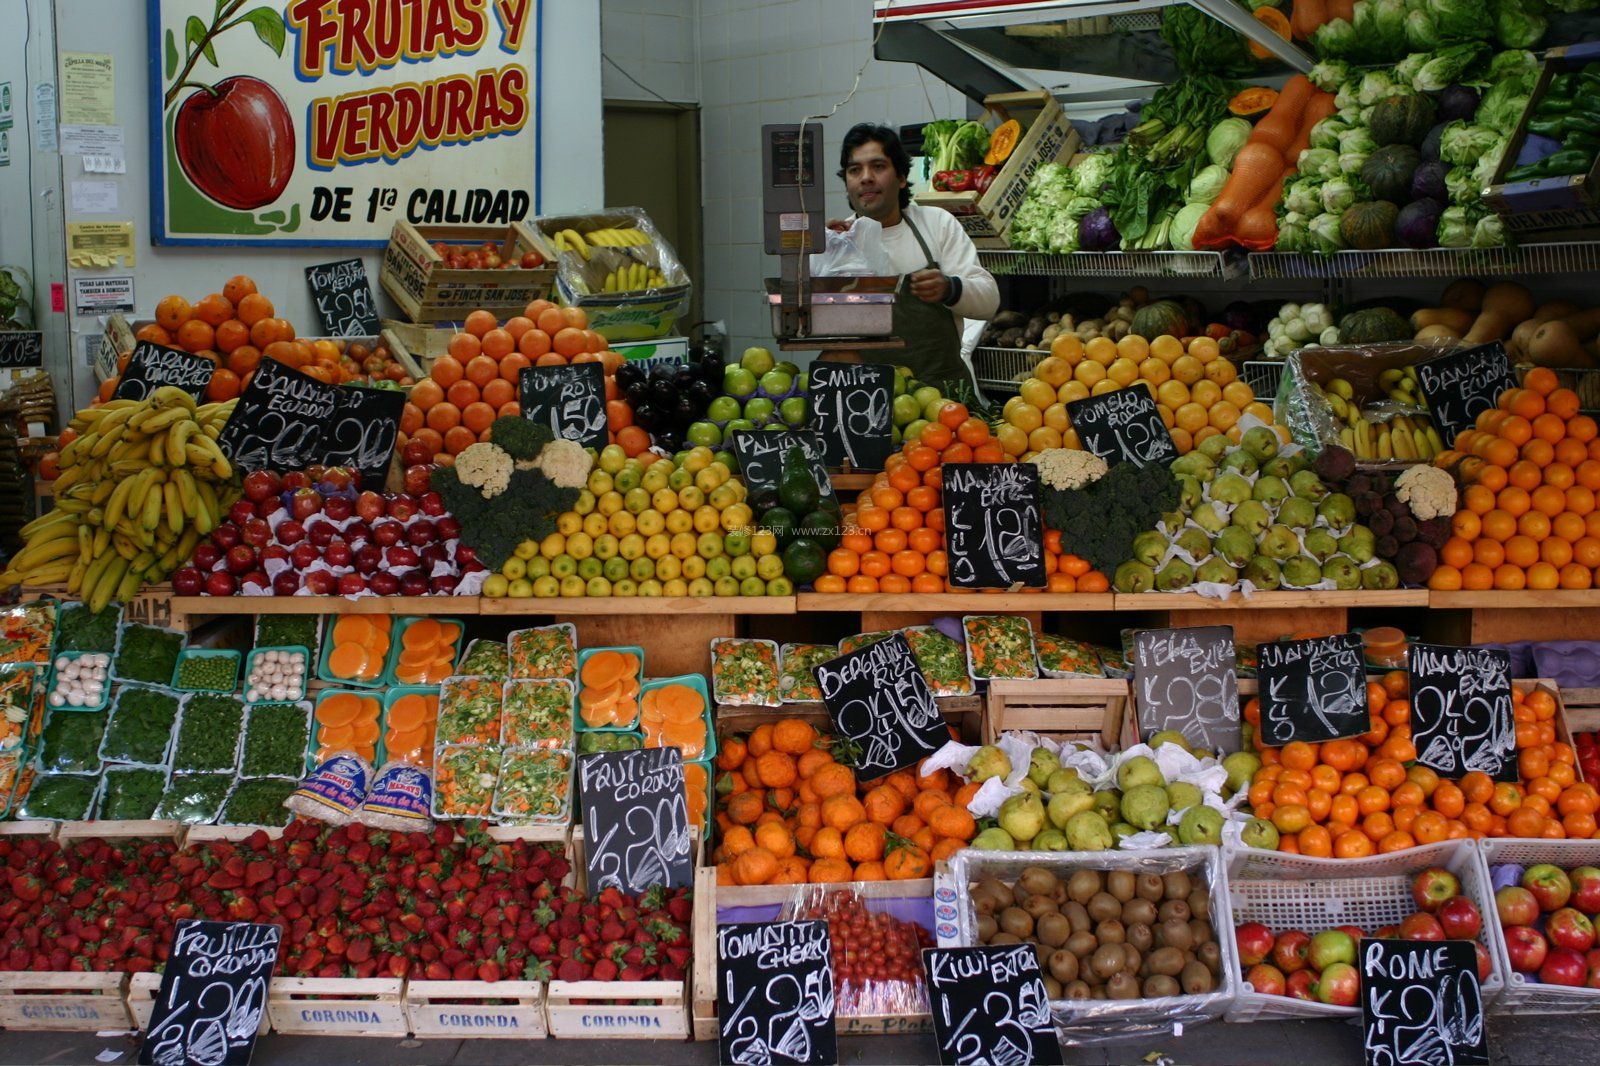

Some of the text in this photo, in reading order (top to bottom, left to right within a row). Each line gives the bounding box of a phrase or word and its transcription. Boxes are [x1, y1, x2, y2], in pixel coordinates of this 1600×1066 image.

[288, 0, 526, 82] FRUTAS Y
[306, 63, 530, 172] VERDURAS
[1006, 180, 1028, 207] FINCA
[1024, 161, 1039, 180] SAN
[309, 186, 353, 222] DE
[406, 188, 530, 224] CALIDAD
[308, 260, 359, 291] TOMATE
[386, 248, 402, 275] SAN
[404, 272, 427, 299] JOSE
[452, 289, 482, 301] FINCA
[485, 289, 504, 301] SAN
[810, 365, 880, 390] SMITH
[833, 388, 890, 467] 180
[174, 921, 278, 957] FRUTILLA
[1365, 942, 1456, 980] ROME
[302, 1009, 382, 1024] CORONDA
[439, 1013, 519, 1028] CORONDA
[582, 1014, 661, 1028] CORONDA
[766, 966, 834, 1063] 250
